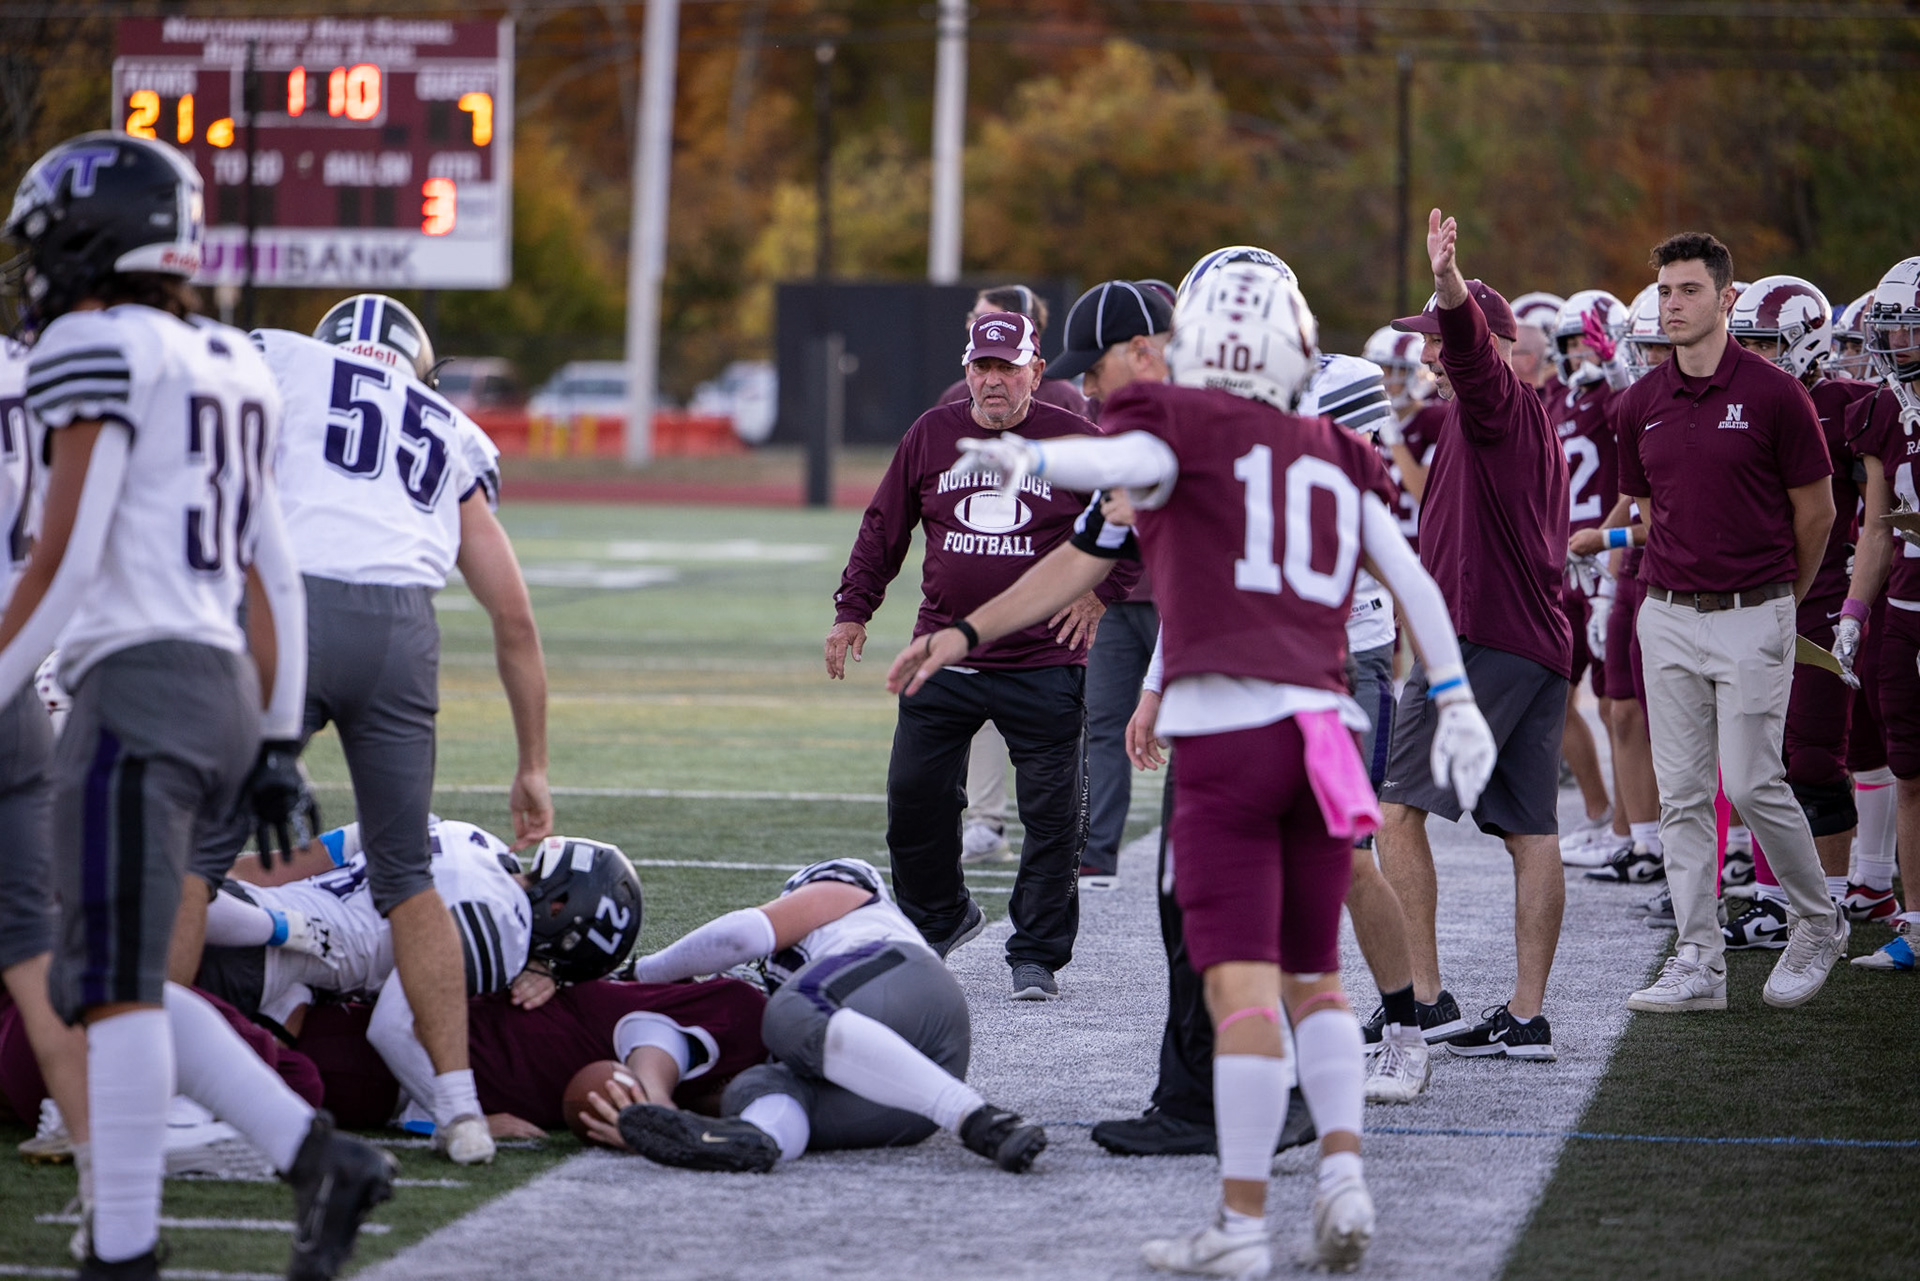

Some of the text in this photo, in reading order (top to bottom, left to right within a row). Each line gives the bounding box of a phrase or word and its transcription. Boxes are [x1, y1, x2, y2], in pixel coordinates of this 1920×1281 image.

[126, 89, 194, 144] 21
[458, 91, 494, 146] 7
[421, 177, 457, 237] 3
[339, 343, 397, 366] ddell
[1217, 342, 1251, 373] 10
[323, 357, 457, 514] 55
[1717, 420, 1749, 429] ATHLETICS
[1725, 403, 1743, 421] N
[187, 395, 265, 572] 30
[1562, 434, 1602, 523] 2
[943, 531, 1035, 556] FOOTBALL
[1233, 443, 1361, 609] 10
[587, 895, 631, 956] 27
